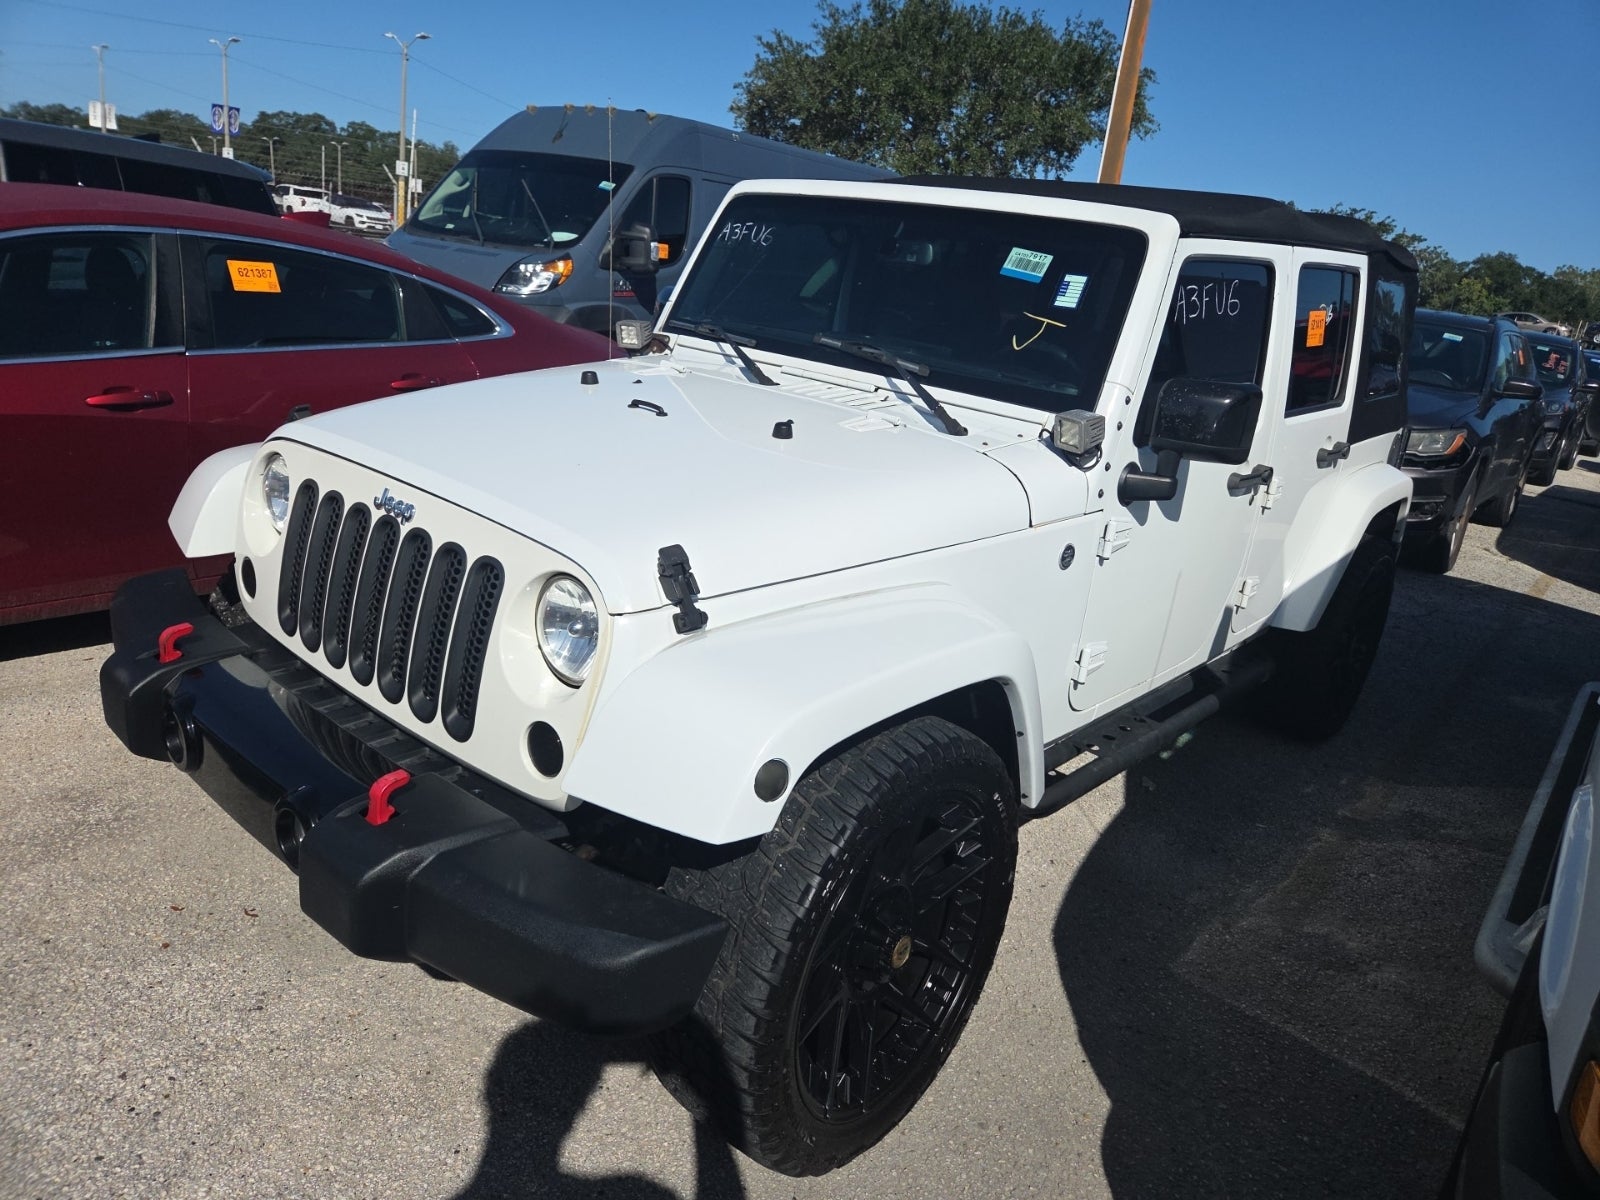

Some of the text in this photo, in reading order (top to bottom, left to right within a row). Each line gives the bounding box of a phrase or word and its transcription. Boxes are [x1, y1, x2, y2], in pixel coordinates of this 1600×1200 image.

[717, 221, 776, 246] A3FU6
[237, 267, 272, 279] 621387
[1174, 279, 1241, 325] A3FU6
[373, 487, 416, 526] Jeep
